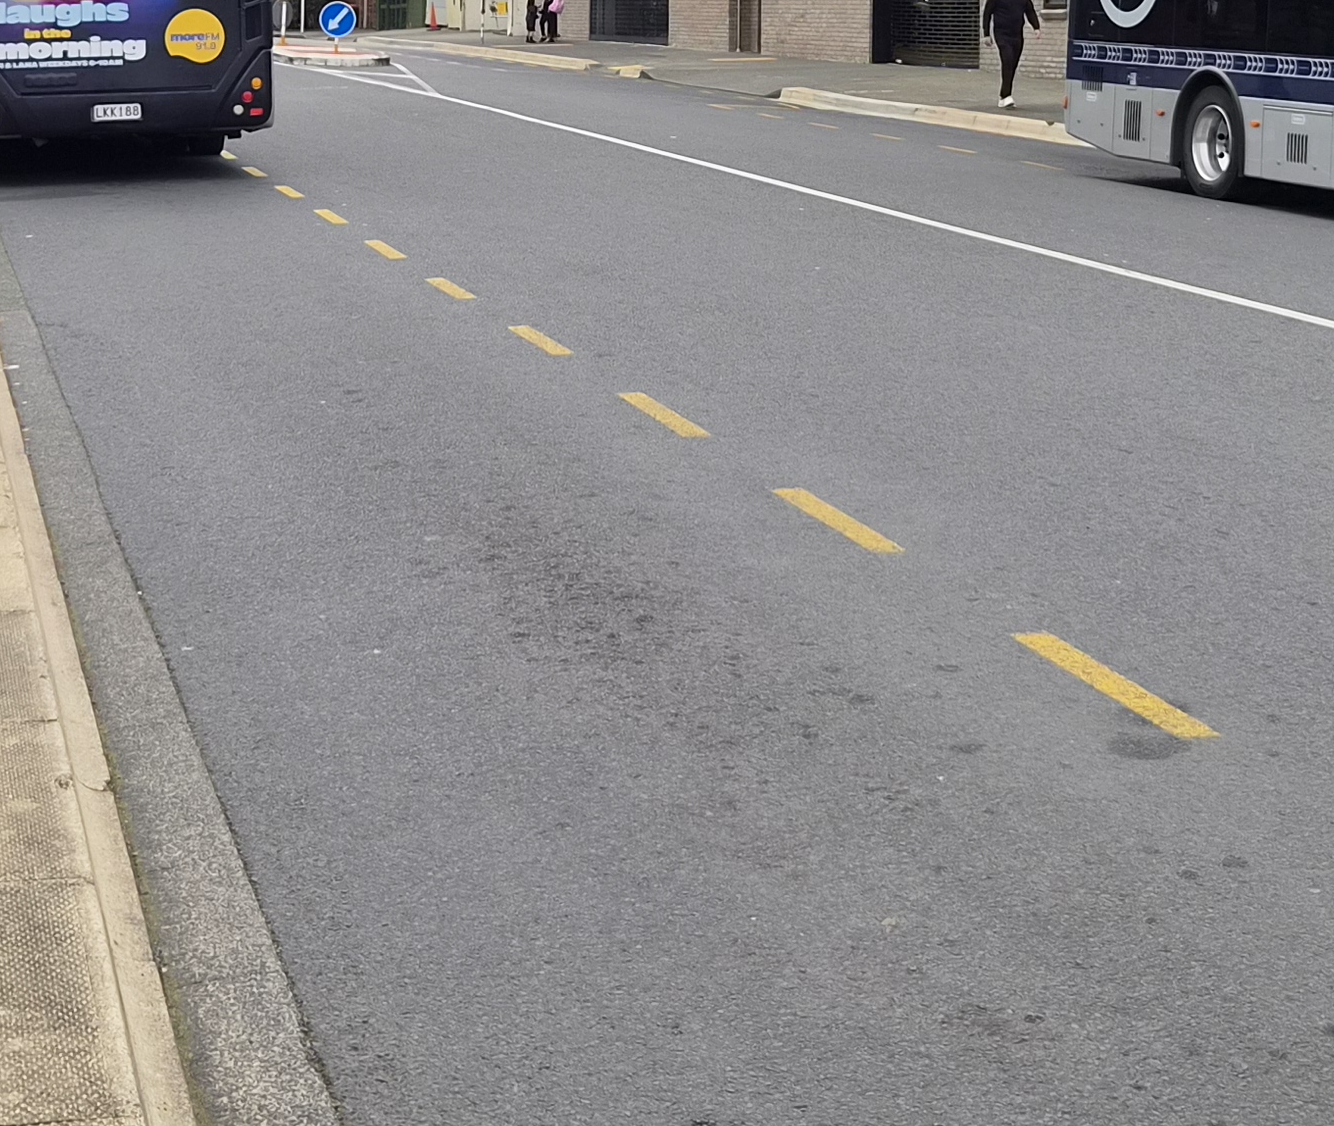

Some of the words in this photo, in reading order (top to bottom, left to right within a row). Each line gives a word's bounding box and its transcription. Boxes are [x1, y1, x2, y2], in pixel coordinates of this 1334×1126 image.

[23, 28, 41, 40] in
[42, 28, 71, 39] the
[38, 60, 88, 68] WEEKDAYS
[95, 105, 140, 118] LKK188
